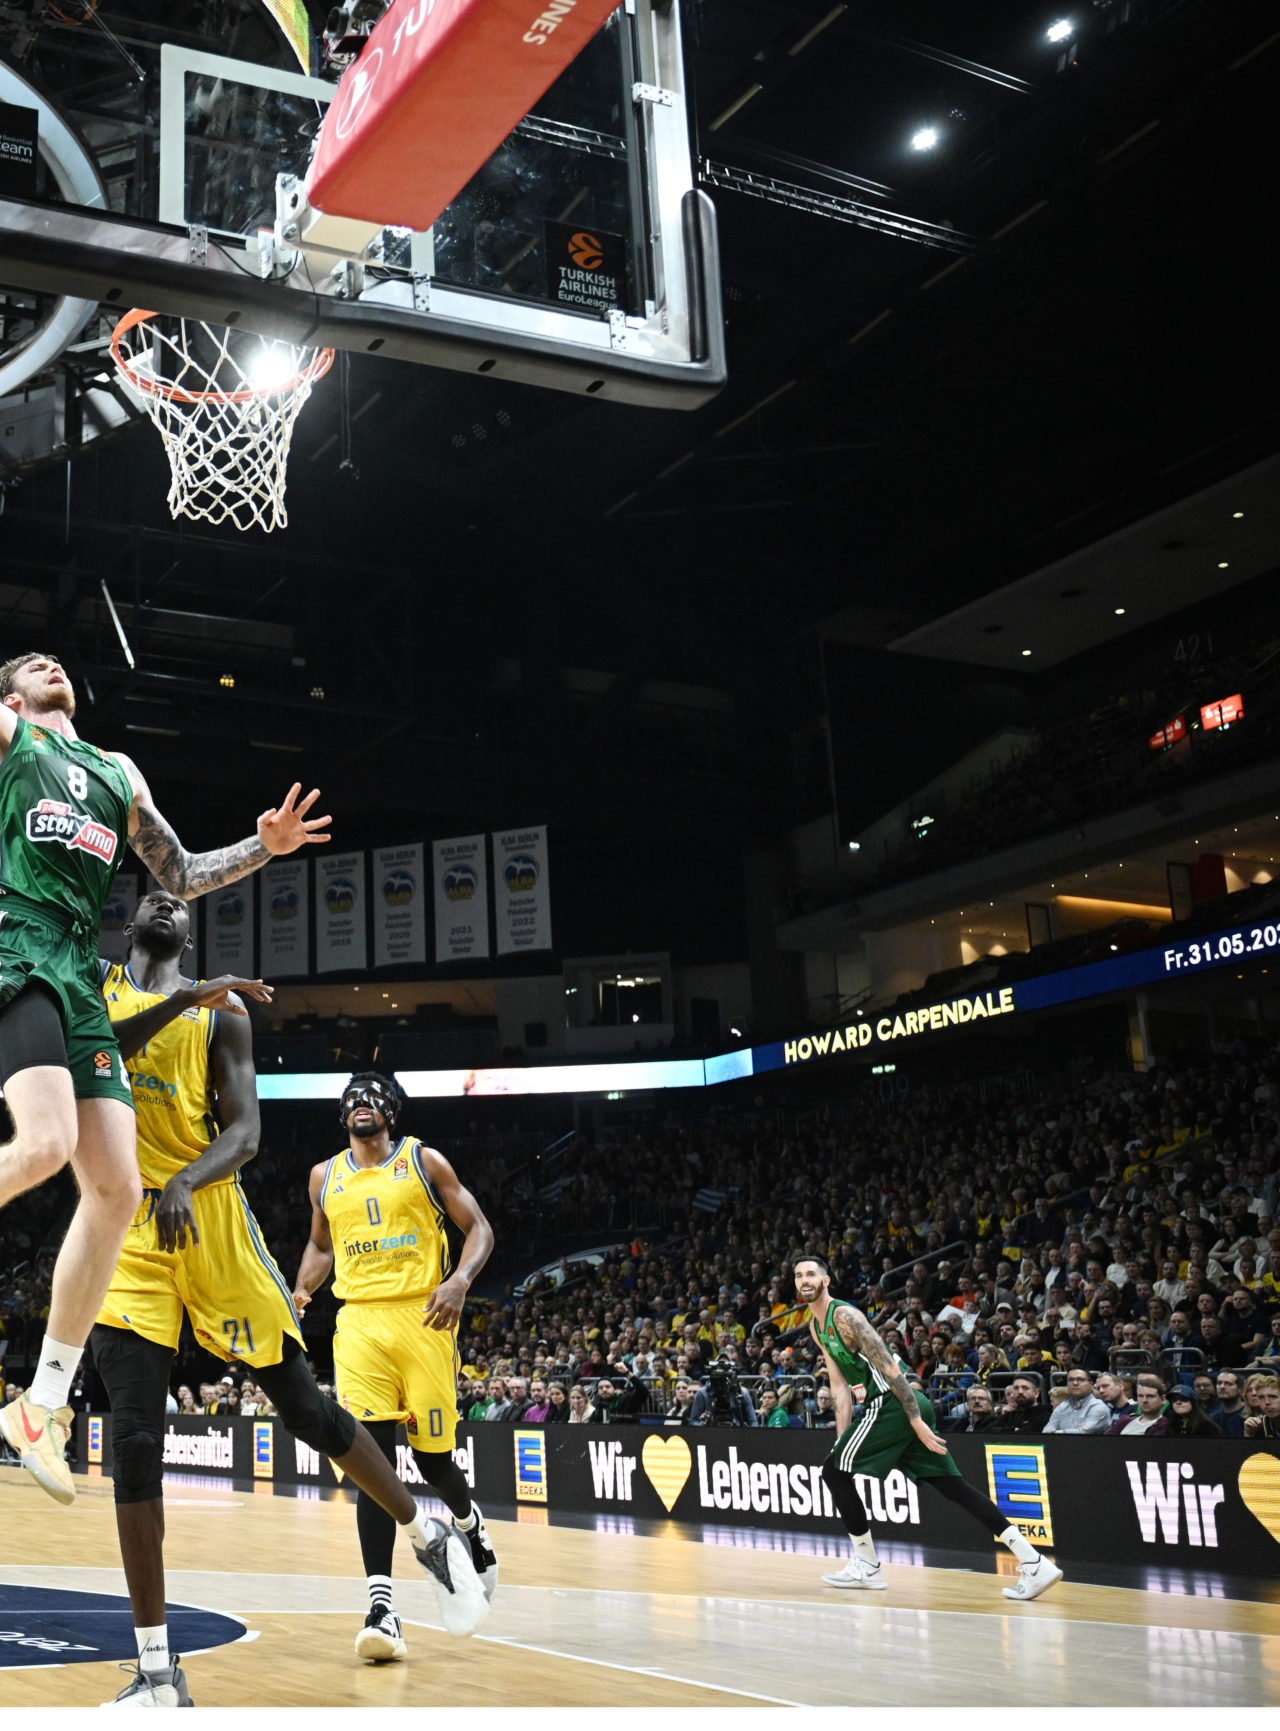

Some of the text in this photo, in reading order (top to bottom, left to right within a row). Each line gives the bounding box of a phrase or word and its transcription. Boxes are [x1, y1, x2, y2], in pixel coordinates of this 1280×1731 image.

[558, 266, 615, 288] TURKISH
[558, 278, 617, 300] AIRLINES
[558, 290, 618, 310] EuroLeague
[1174, 632, 1215, 663] 421
[68, 765, 88, 800] 8
[784, 987, 1015, 1064] HOWARD CARPENDALE
[134, 1093, 177, 1112] solutions
[366, 1197, 381, 1225] 0
[343, 1233, 417, 1257] interzero
[222, 1317, 256, 1353] 21
[431, 1409, 443, 1437] 0
[162, 1425, 234, 1469] ebensmittel
[588, 1440, 637, 1501] Wir
[520, 1484, 545, 1496] EDEKA
[1125, 1460, 1225, 1547] Wir
[1019, 1523, 1048, 1539] EKA
